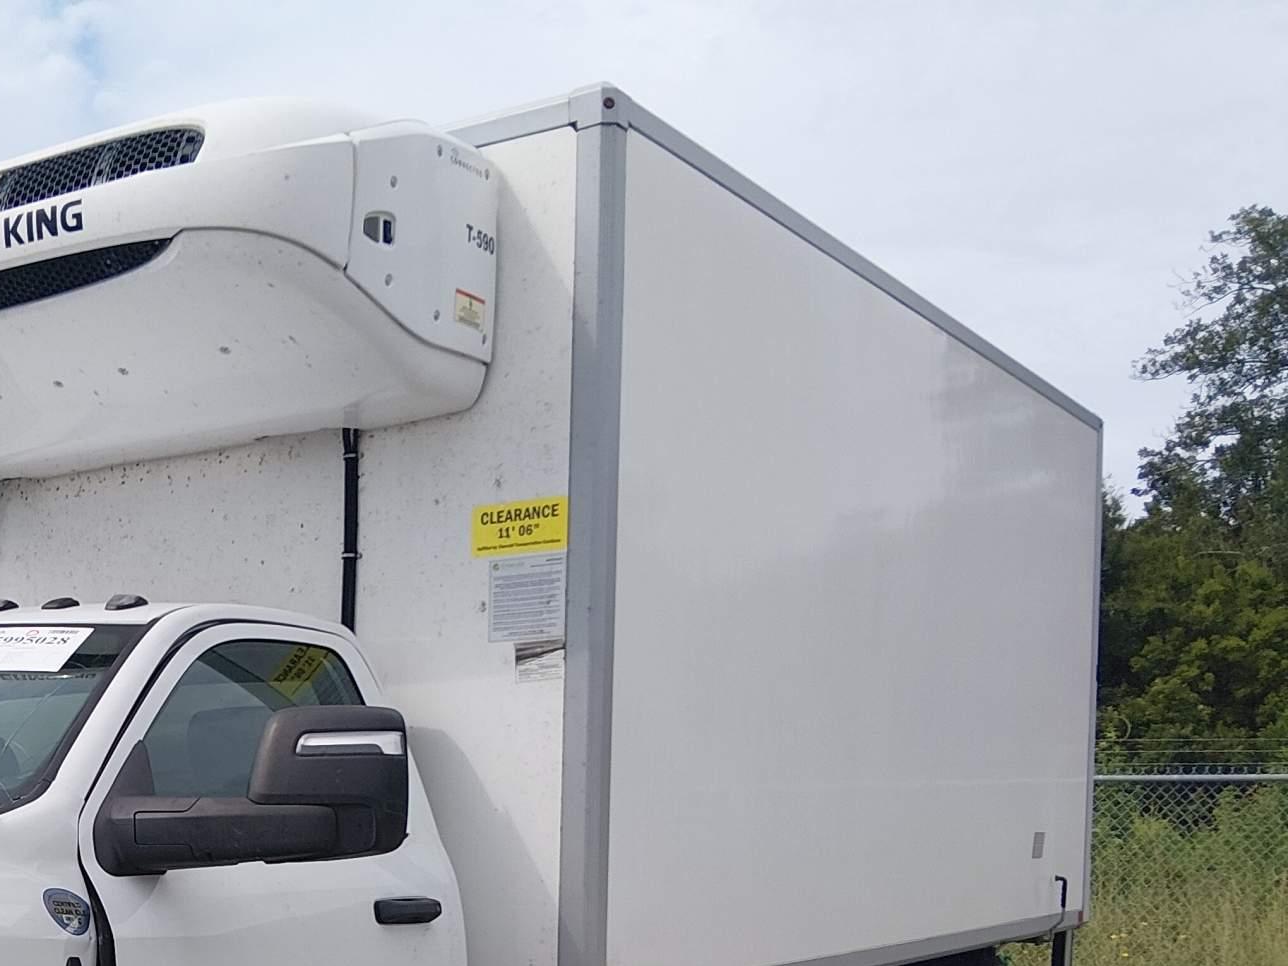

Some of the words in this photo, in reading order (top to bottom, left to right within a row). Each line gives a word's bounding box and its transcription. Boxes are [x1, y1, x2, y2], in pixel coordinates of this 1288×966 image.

[3, 199, 84, 249] KING
[466, 223, 495, 256] T-590
[480, 503, 560, 526] CLEARANCE
[498, 526, 515, 539] 11'
